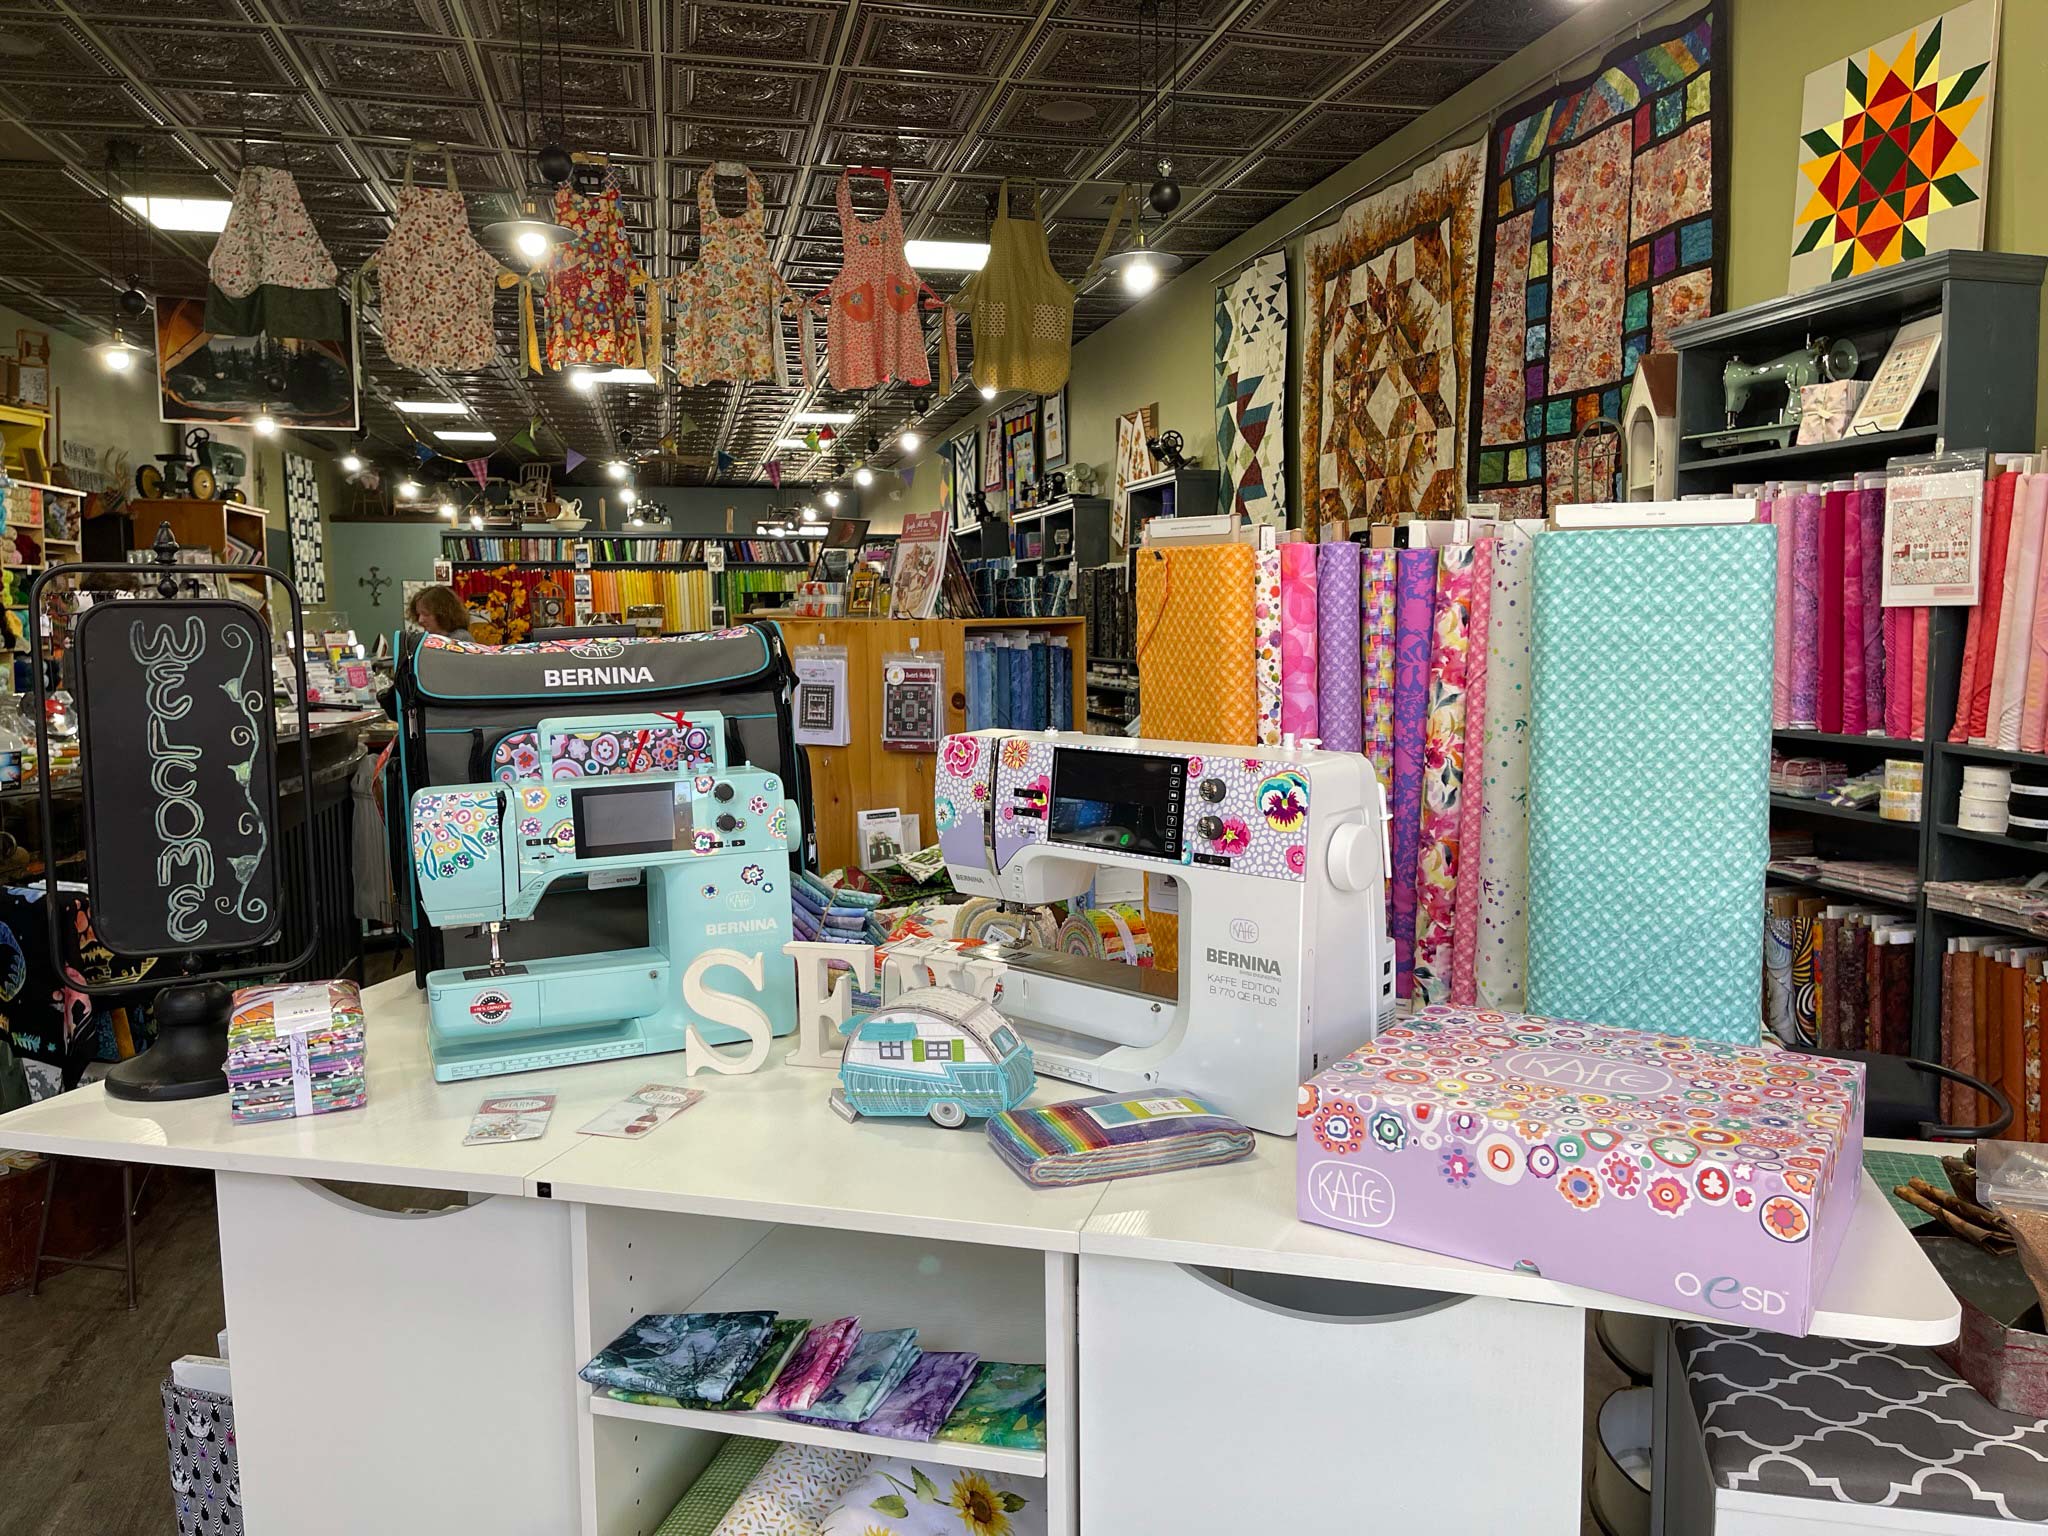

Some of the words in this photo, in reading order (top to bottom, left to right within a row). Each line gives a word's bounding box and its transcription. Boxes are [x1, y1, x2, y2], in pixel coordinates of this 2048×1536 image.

[544, 666, 655, 688] BERNINA
[130, 616, 214, 942] WELCOME
[956, 873, 985, 884] BERNINA
[705, 918, 779, 937] BERNINA
[1206, 947, 1282, 977] BERNINA
[1207, 973, 1238, 987] KAFFE
[1241, 980, 1280, 996] EDITION
[1209, 985, 1217, 995] B
[1219, 987, 1236, 999] 770
[1237, 990, 1251, 1002] QE
[1252, 994, 1278, 1008] PLUS
